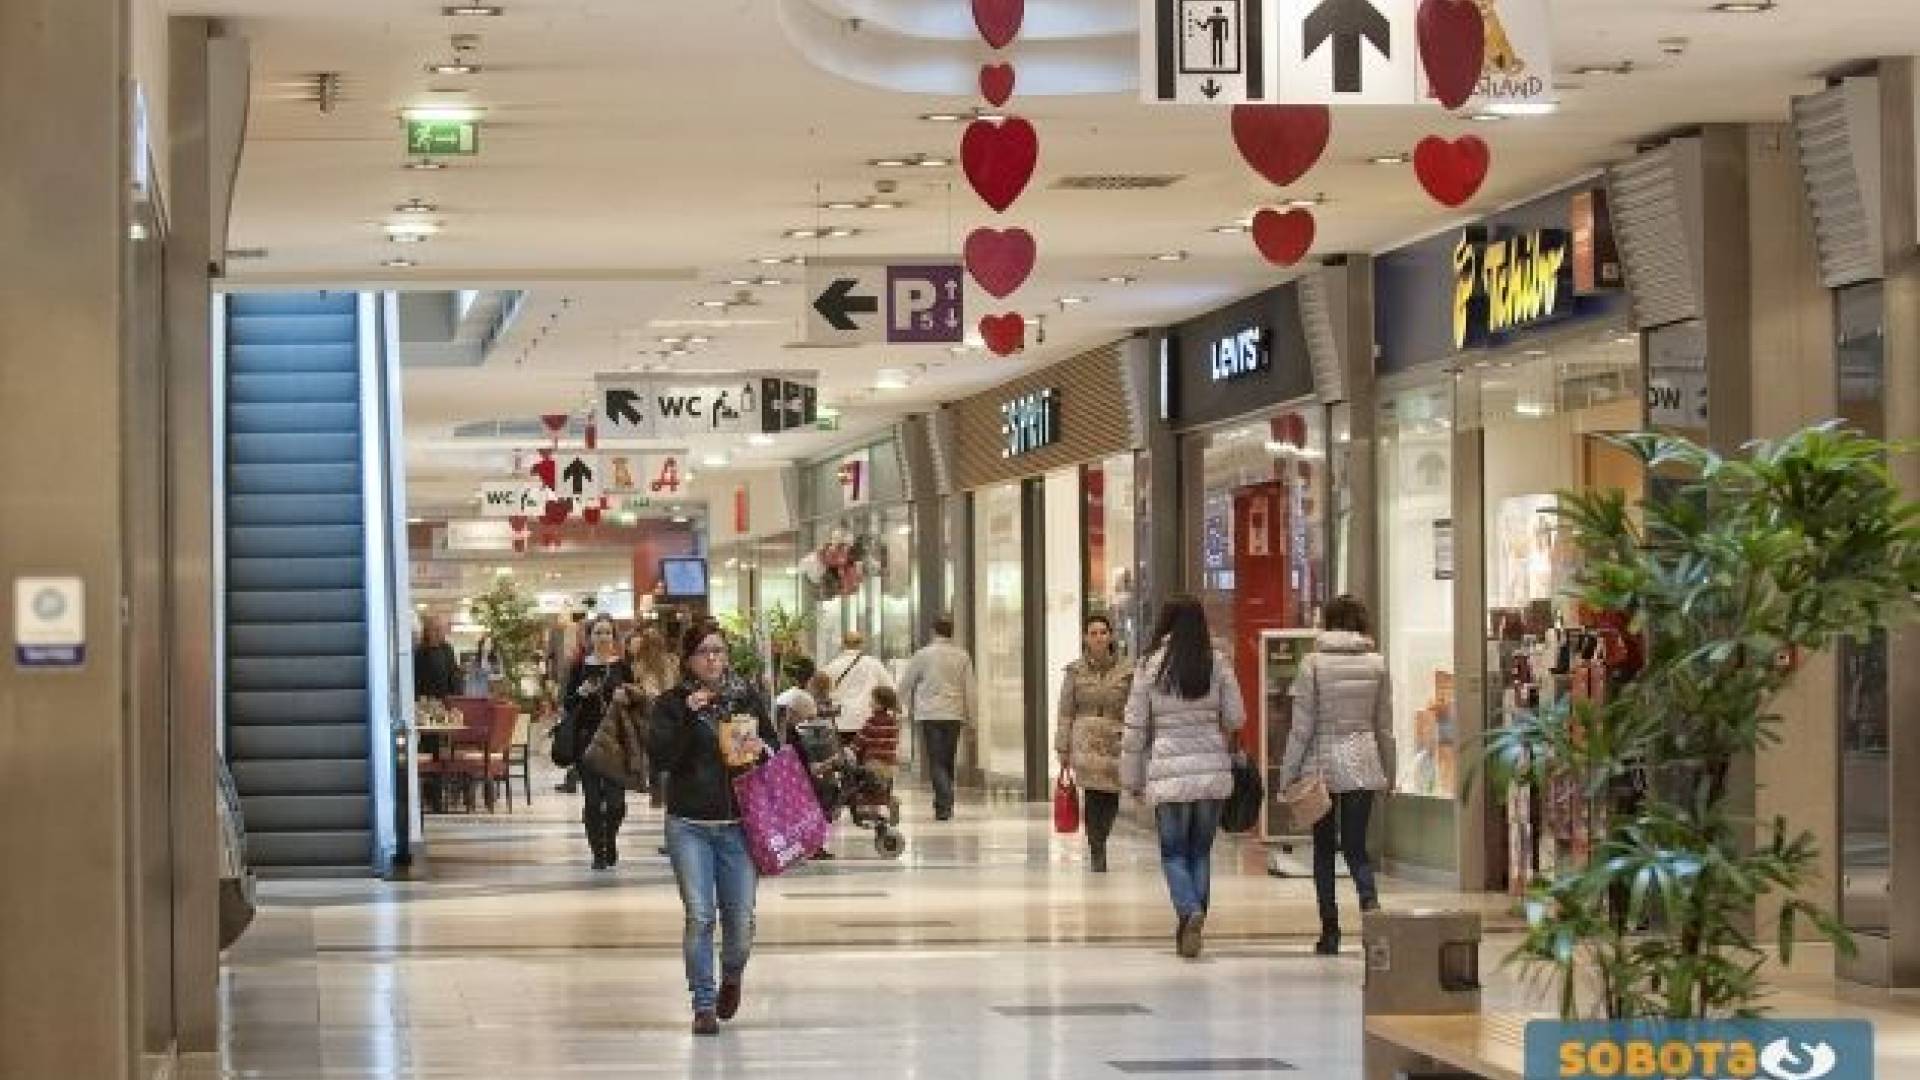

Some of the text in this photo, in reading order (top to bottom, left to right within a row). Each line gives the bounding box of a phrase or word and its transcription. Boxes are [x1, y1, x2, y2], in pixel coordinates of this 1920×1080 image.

[892, 277, 937, 331] P
[657, 396, 702, 418] WC
[487, 490, 512, 505] WC
